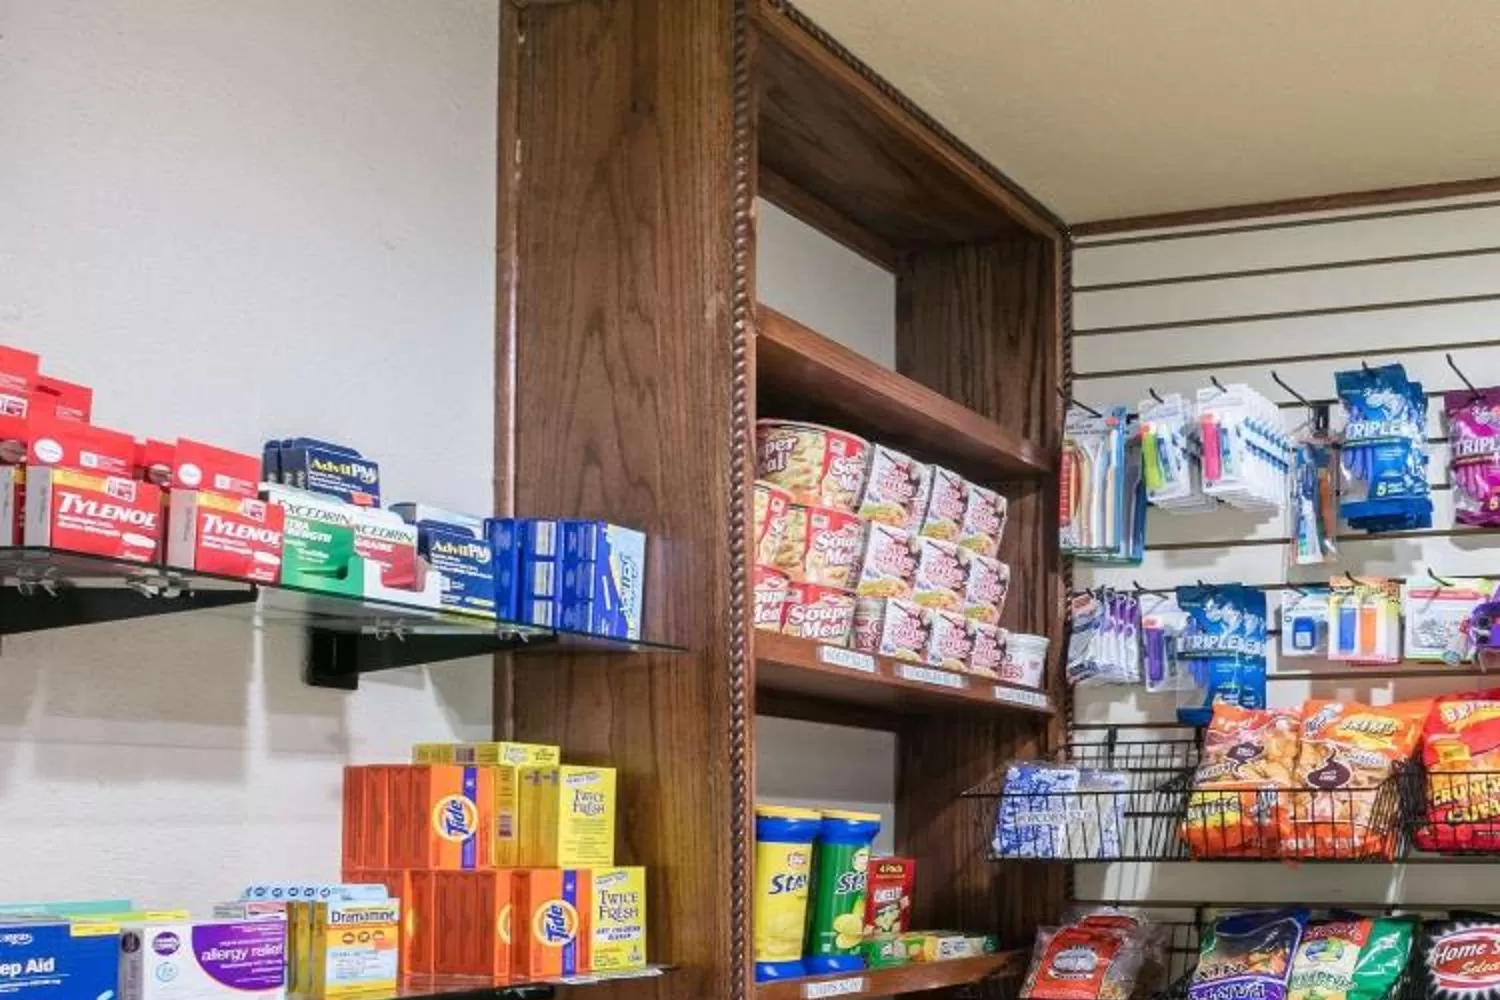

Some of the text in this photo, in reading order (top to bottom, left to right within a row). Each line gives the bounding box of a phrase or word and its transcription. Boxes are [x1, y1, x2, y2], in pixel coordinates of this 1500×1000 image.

[310, 458, 352, 476] Advil
[58, 492, 156, 529] TYLENOL
[202, 513, 281, 547] TYLENOL
[355, 524, 414, 542] XCEDRIN
[433, 539, 470, 557] Advil
[446, 799, 470, 838] Tide
[834, 872, 867, 895] Sta
[598, 889, 639, 906] TWICE
[330, 908, 396, 925] Dramamine
[598, 905, 640, 923] FRESH
[544, 904, 569, 943] Tide
[201, 947, 249, 963] allergy
[1433, 939, 1488, 965] Home
[25, 957, 56, 974] Aid
